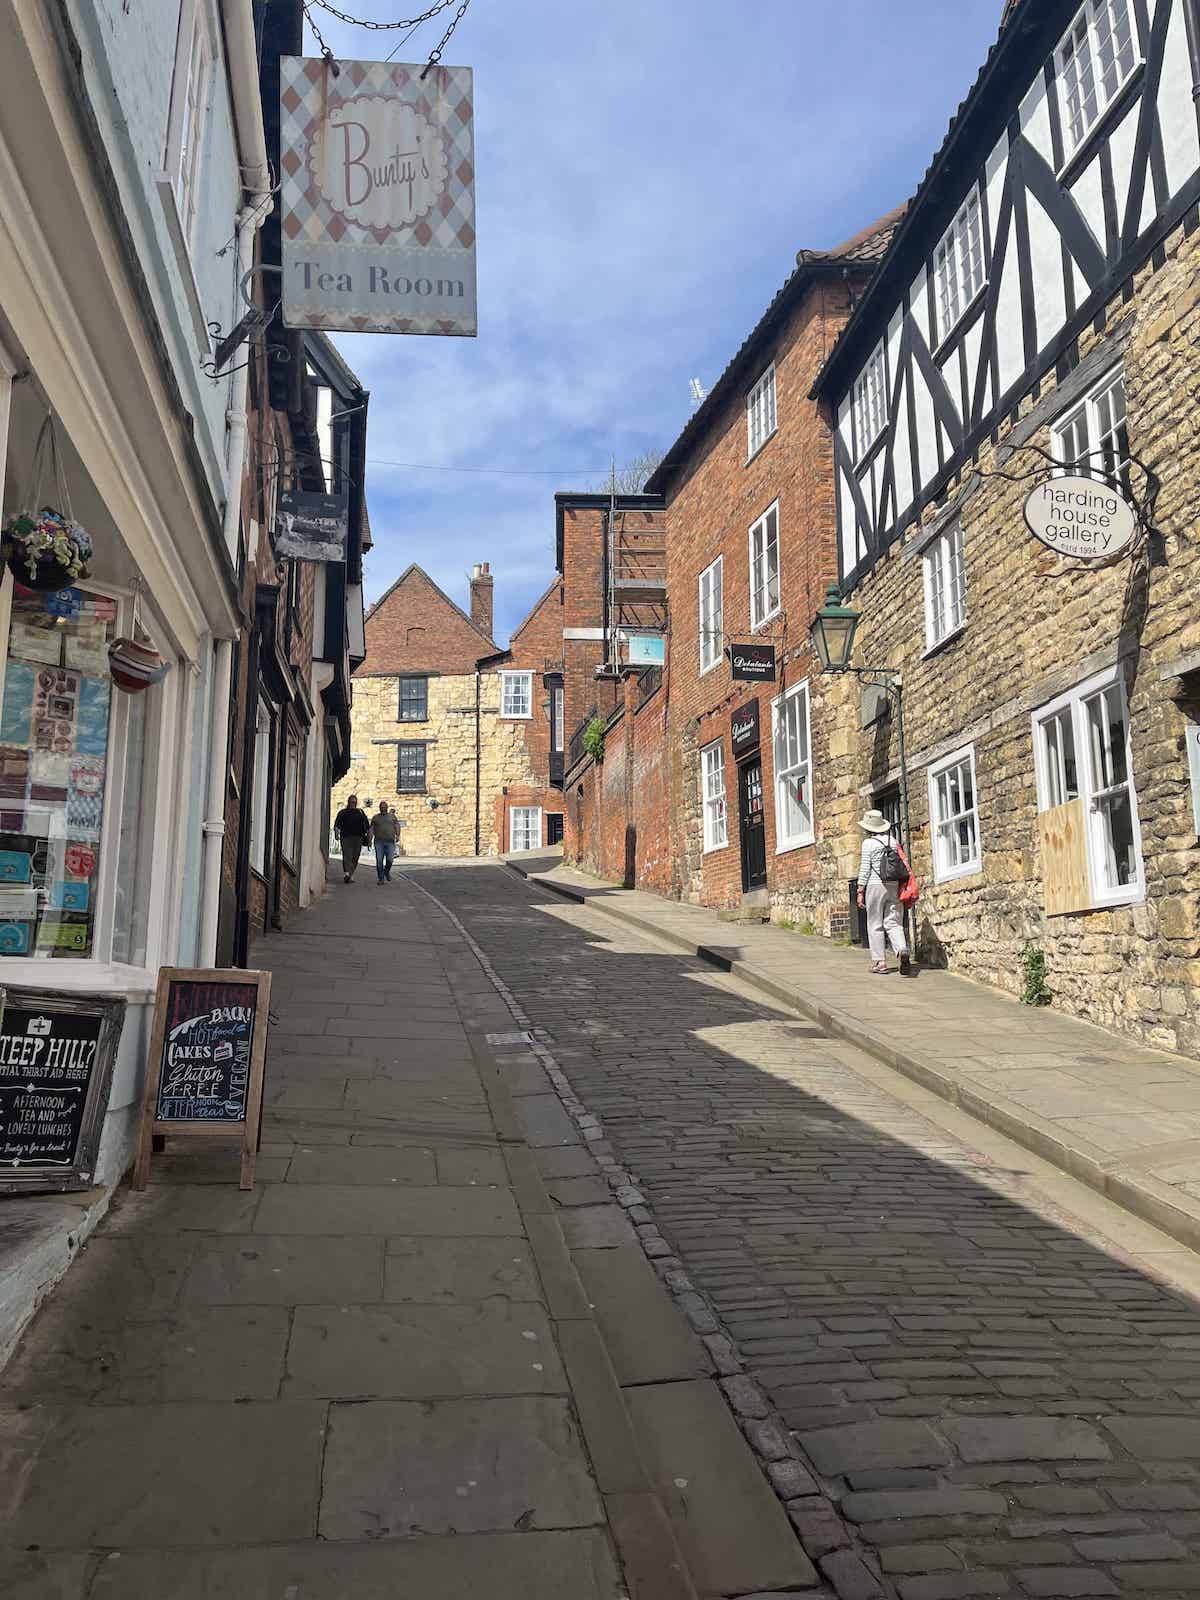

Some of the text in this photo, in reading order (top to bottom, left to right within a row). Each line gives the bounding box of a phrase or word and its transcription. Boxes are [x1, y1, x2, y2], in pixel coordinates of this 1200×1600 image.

[331, 121, 429, 211] Bunty's
[295, 262, 464, 297] Tea Room
[1043, 484, 1117, 515] harding
[1051, 502, 1110, 528] house
[1045, 524, 1112, 549] gallery
[208, 1006, 251, 1025] BACK!
[45, 1038, 96, 1069] HILL?
[168, 1042, 211, 1067] CAKES
[49, 1068, 64, 1078] AID
[163, 1063, 224, 1093] Gluten
[229, 1039, 248, 1100] VEGAN
[13, 1095, 65, 1109] AFTERNOON
[20, 1109, 56, 1121] TEA AND
[7, 1122, 72, 1136] LOVELY LUNCHES
